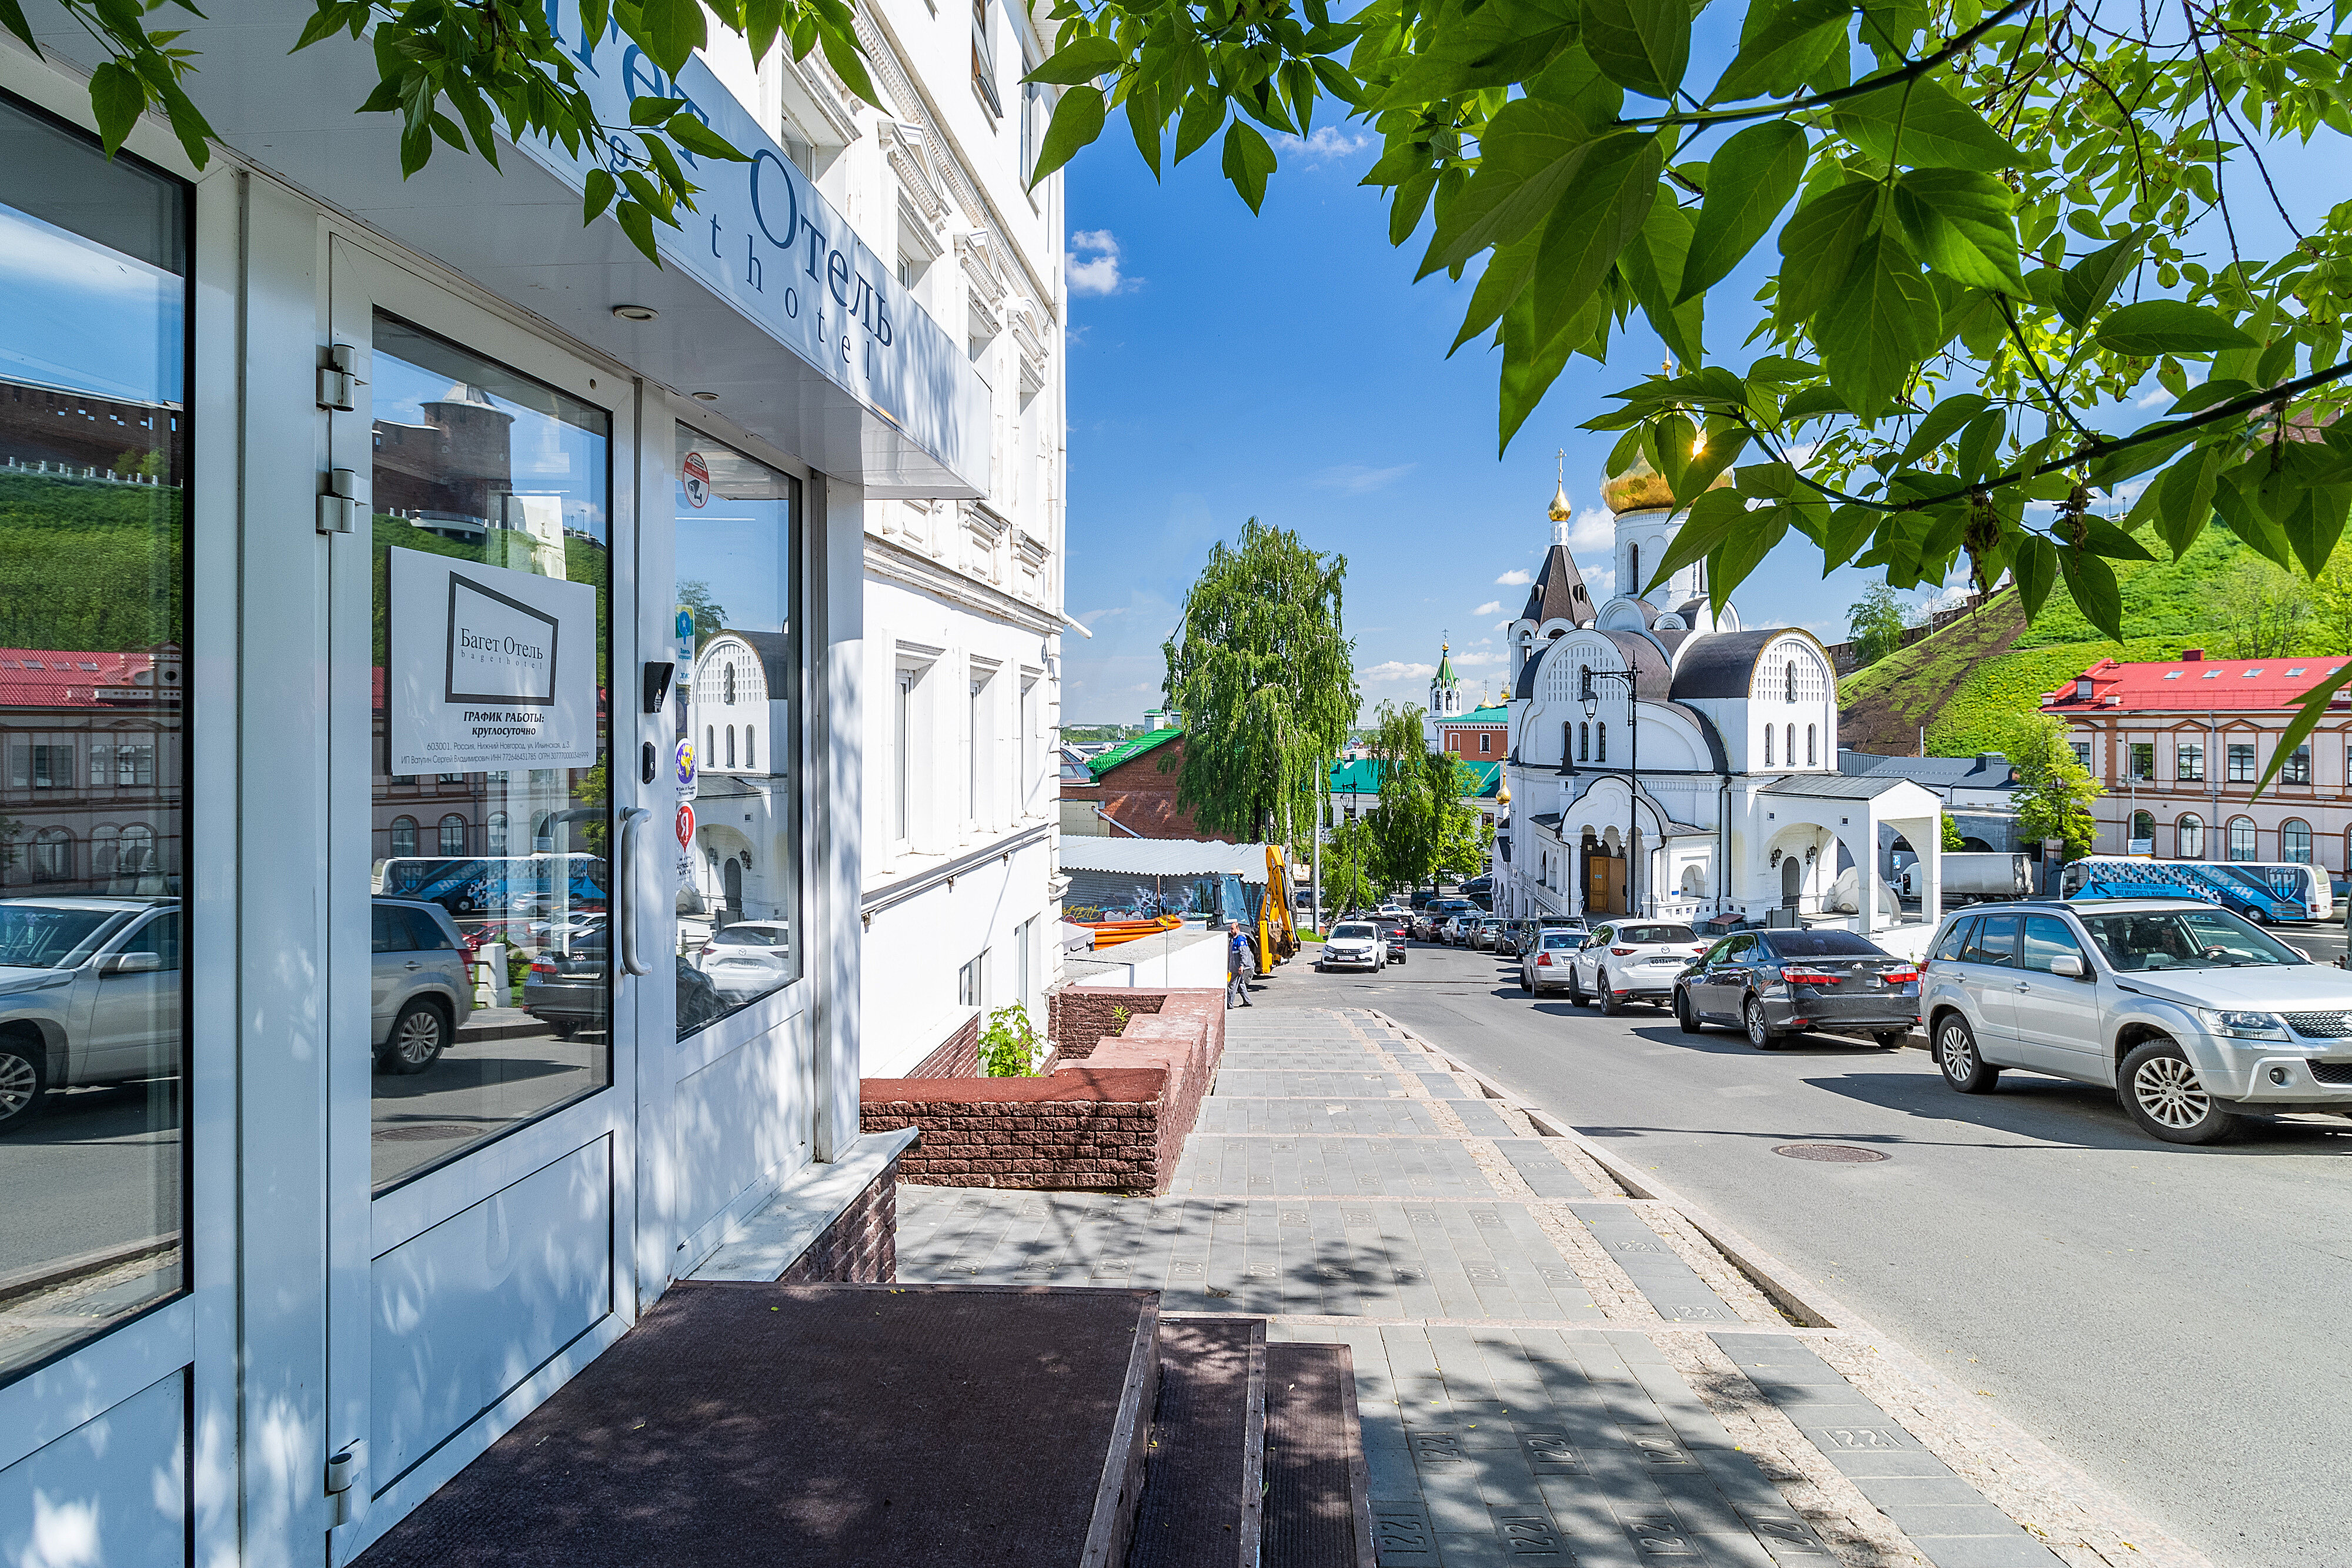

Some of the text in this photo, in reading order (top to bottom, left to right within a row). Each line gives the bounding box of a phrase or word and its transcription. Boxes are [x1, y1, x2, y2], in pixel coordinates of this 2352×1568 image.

[750, 149, 893, 347] Отель
[460, 628, 544, 660] Багет Отель
[460, 650, 543, 669] bagethotel
[463, 711, 544, 723] ГРАФИК РАБОТЫ:
[472, 726, 536, 738] круглосуточно
[401, 755, 410, 764] ИП
[411, 755, 432, 765] Ватутин
[433, 755, 453, 765] Сергей
[454, 754, 490, 764] Владимирович
[490, 754, 502, 762] ИНН
[538, 752, 550, 760] ОГРН
[427, 742, 452, 751] 603001,
[1612, 1241, 1661, 1253] 1221
[1670, 1305, 1727, 1320] 1221
[1414, 1431, 1462, 1463] 1221
[1525, 1432, 1577, 1465] 1221
[1632, 1433, 1689, 1465] 1221
[1823, 1429, 1903, 1449] 1221
[1376, 1513, 1428, 1553] 1221
[1500, 1515, 1559, 1556] 1221
[1625, 1514, 1696, 1556] 1221
[1751, 1514, 1823, 1556] 1221
